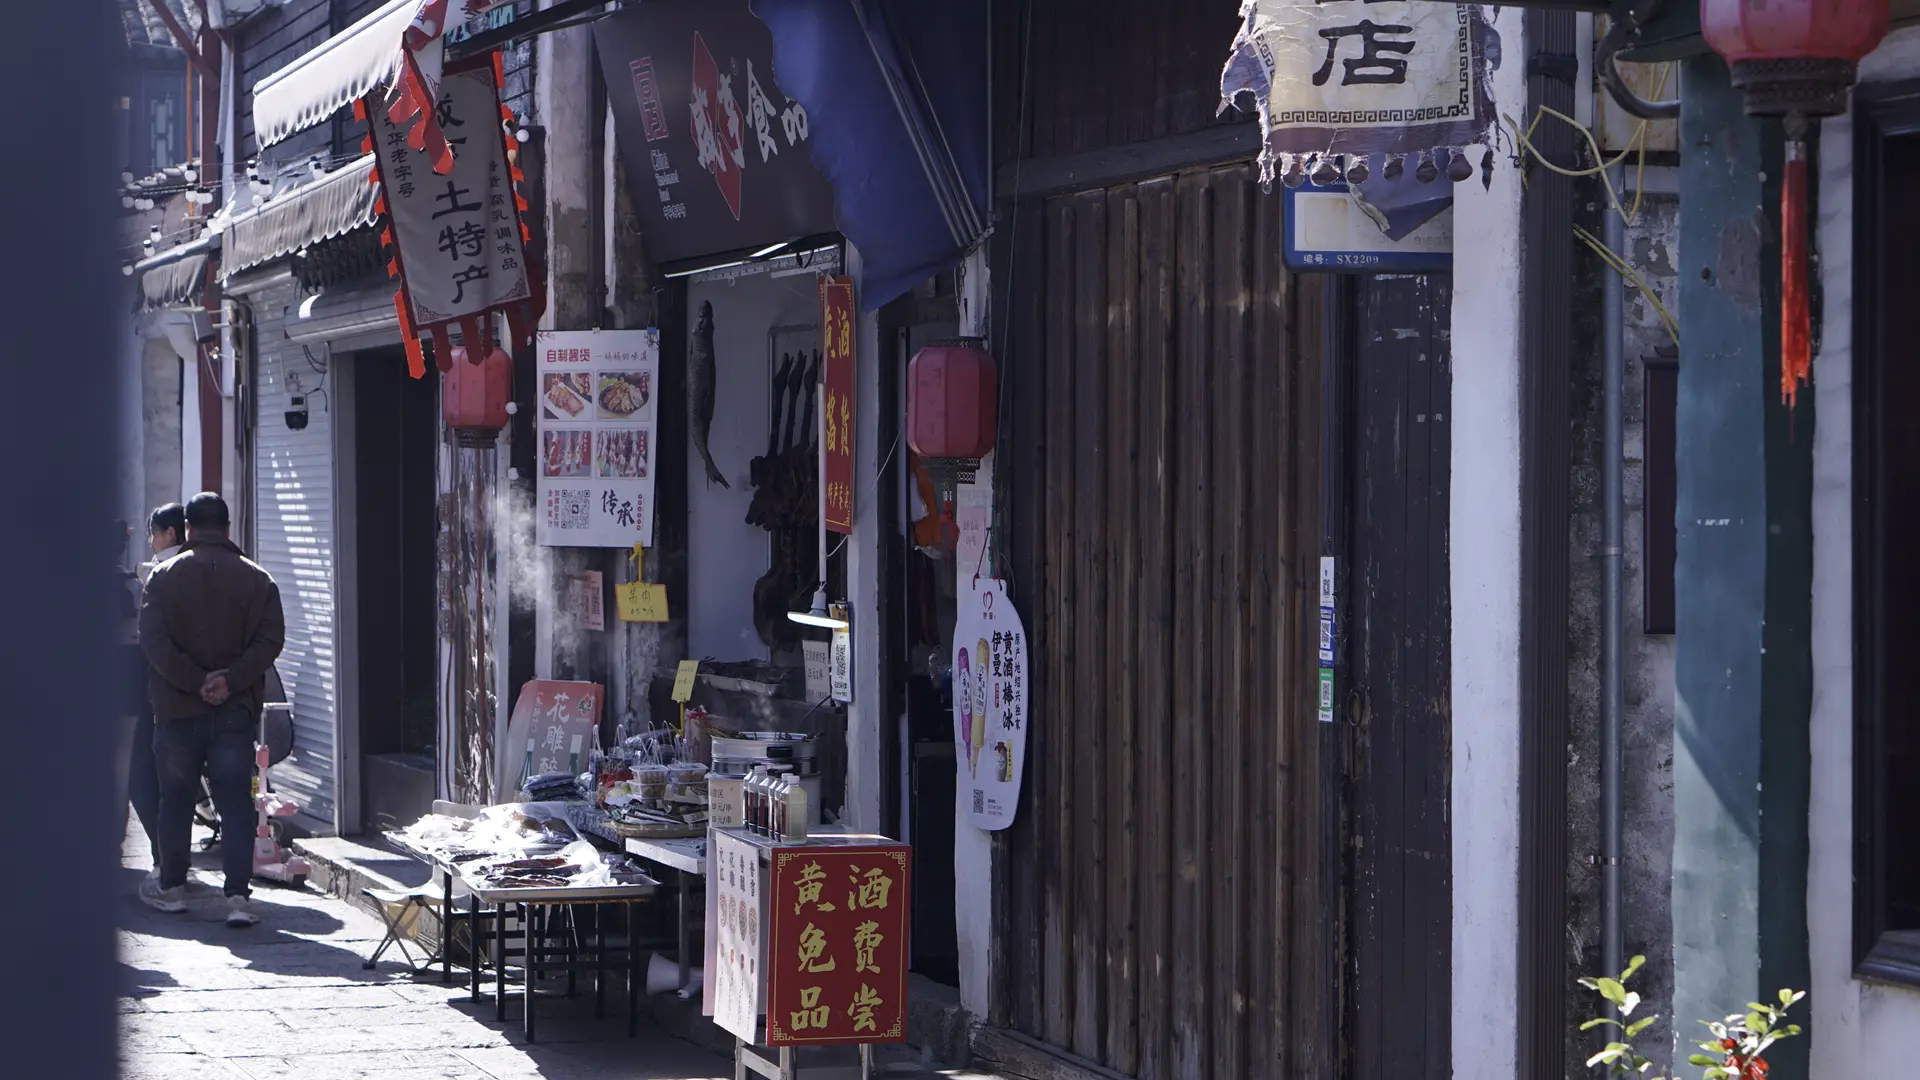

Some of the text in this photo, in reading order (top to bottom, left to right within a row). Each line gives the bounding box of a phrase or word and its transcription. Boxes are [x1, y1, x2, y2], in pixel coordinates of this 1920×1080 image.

[1311, 19, 1416, 86] 店
[1337, 254, 1379, 265] SX2209
[546, 348, 591, 362] 自制酱货
[600, 489, 636, 528] 传承
[991, 629, 1003, 678] 伊曼
[1002, 629, 1015, 732] 黄酒棒冰
[793, 860, 893, 915] 黄酒
[798, 920, 884, 974] 免费
[790, 983, 884, 1032] 品尝
